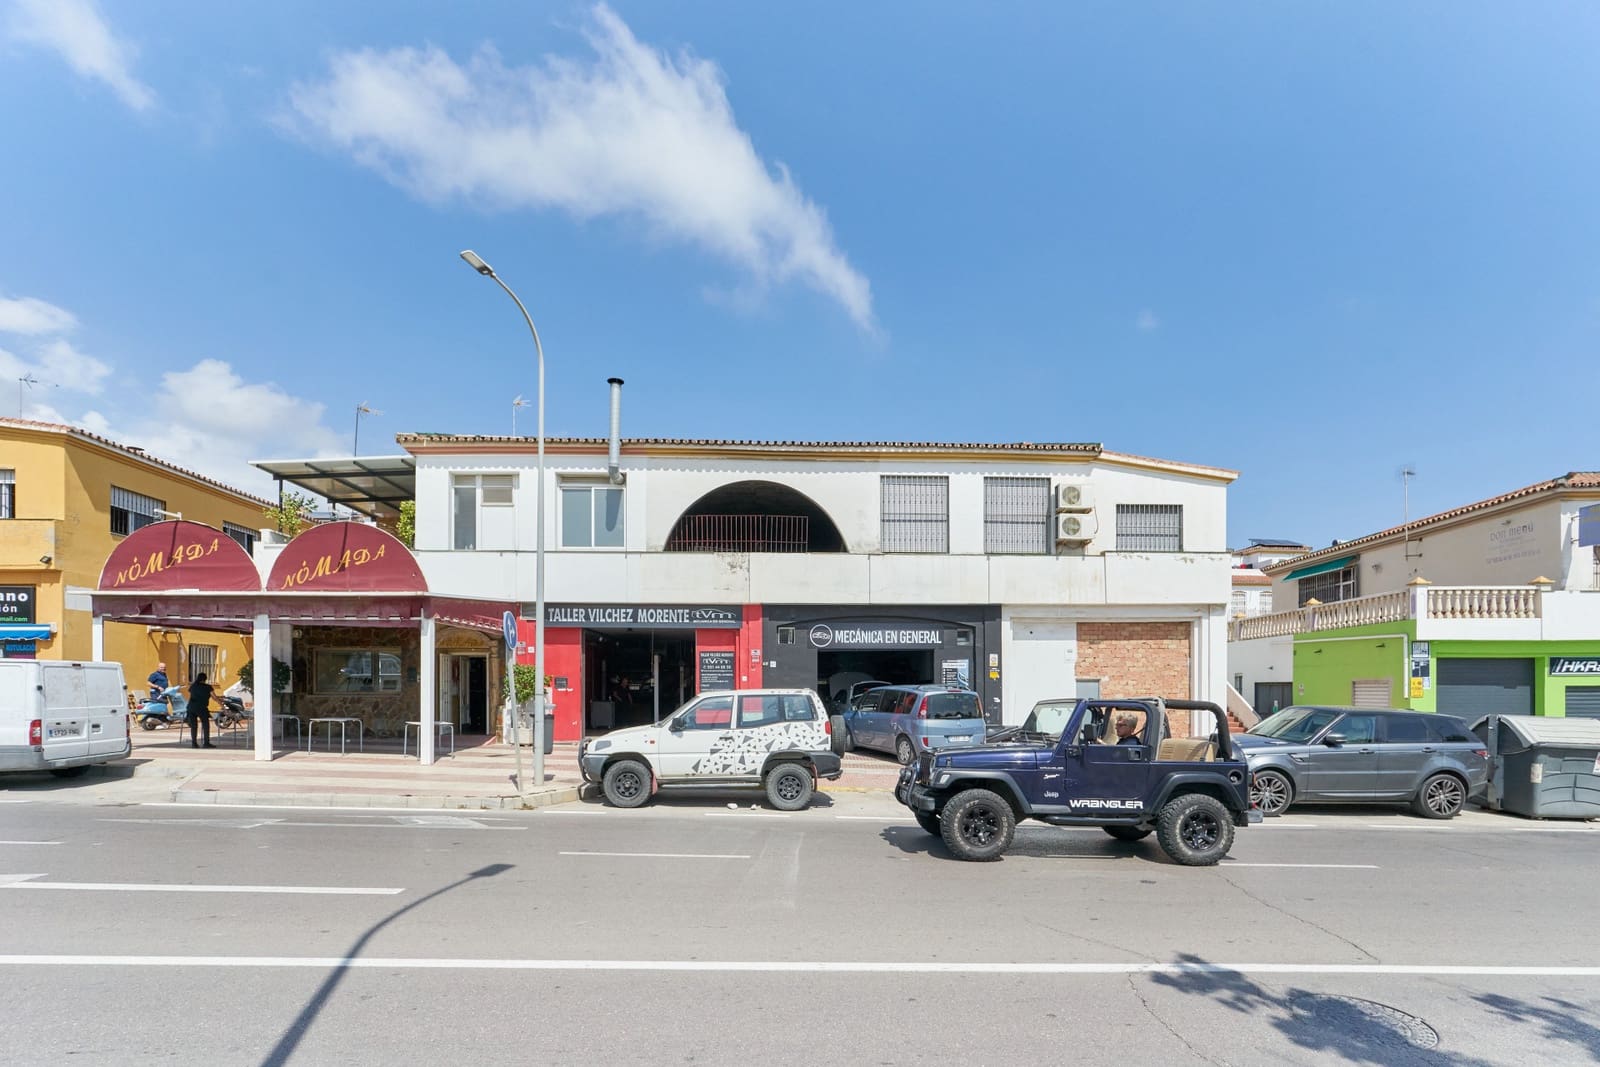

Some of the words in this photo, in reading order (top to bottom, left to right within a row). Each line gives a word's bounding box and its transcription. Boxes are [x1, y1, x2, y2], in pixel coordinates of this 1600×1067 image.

[548, 607, 586, 623] TALLER
[588, 607, 634, 623] VILCHEZ
[637, 608, 690, 623] MORENTE
[835, 628, 883, 644] MECÁNICA
[885, 630, 898, 644] EN
[899, 630, 943, 644] GENERAL
[1043, 790, 1060, 799] Jeep
[1069, 799, 1144, 809] WRANGLER
